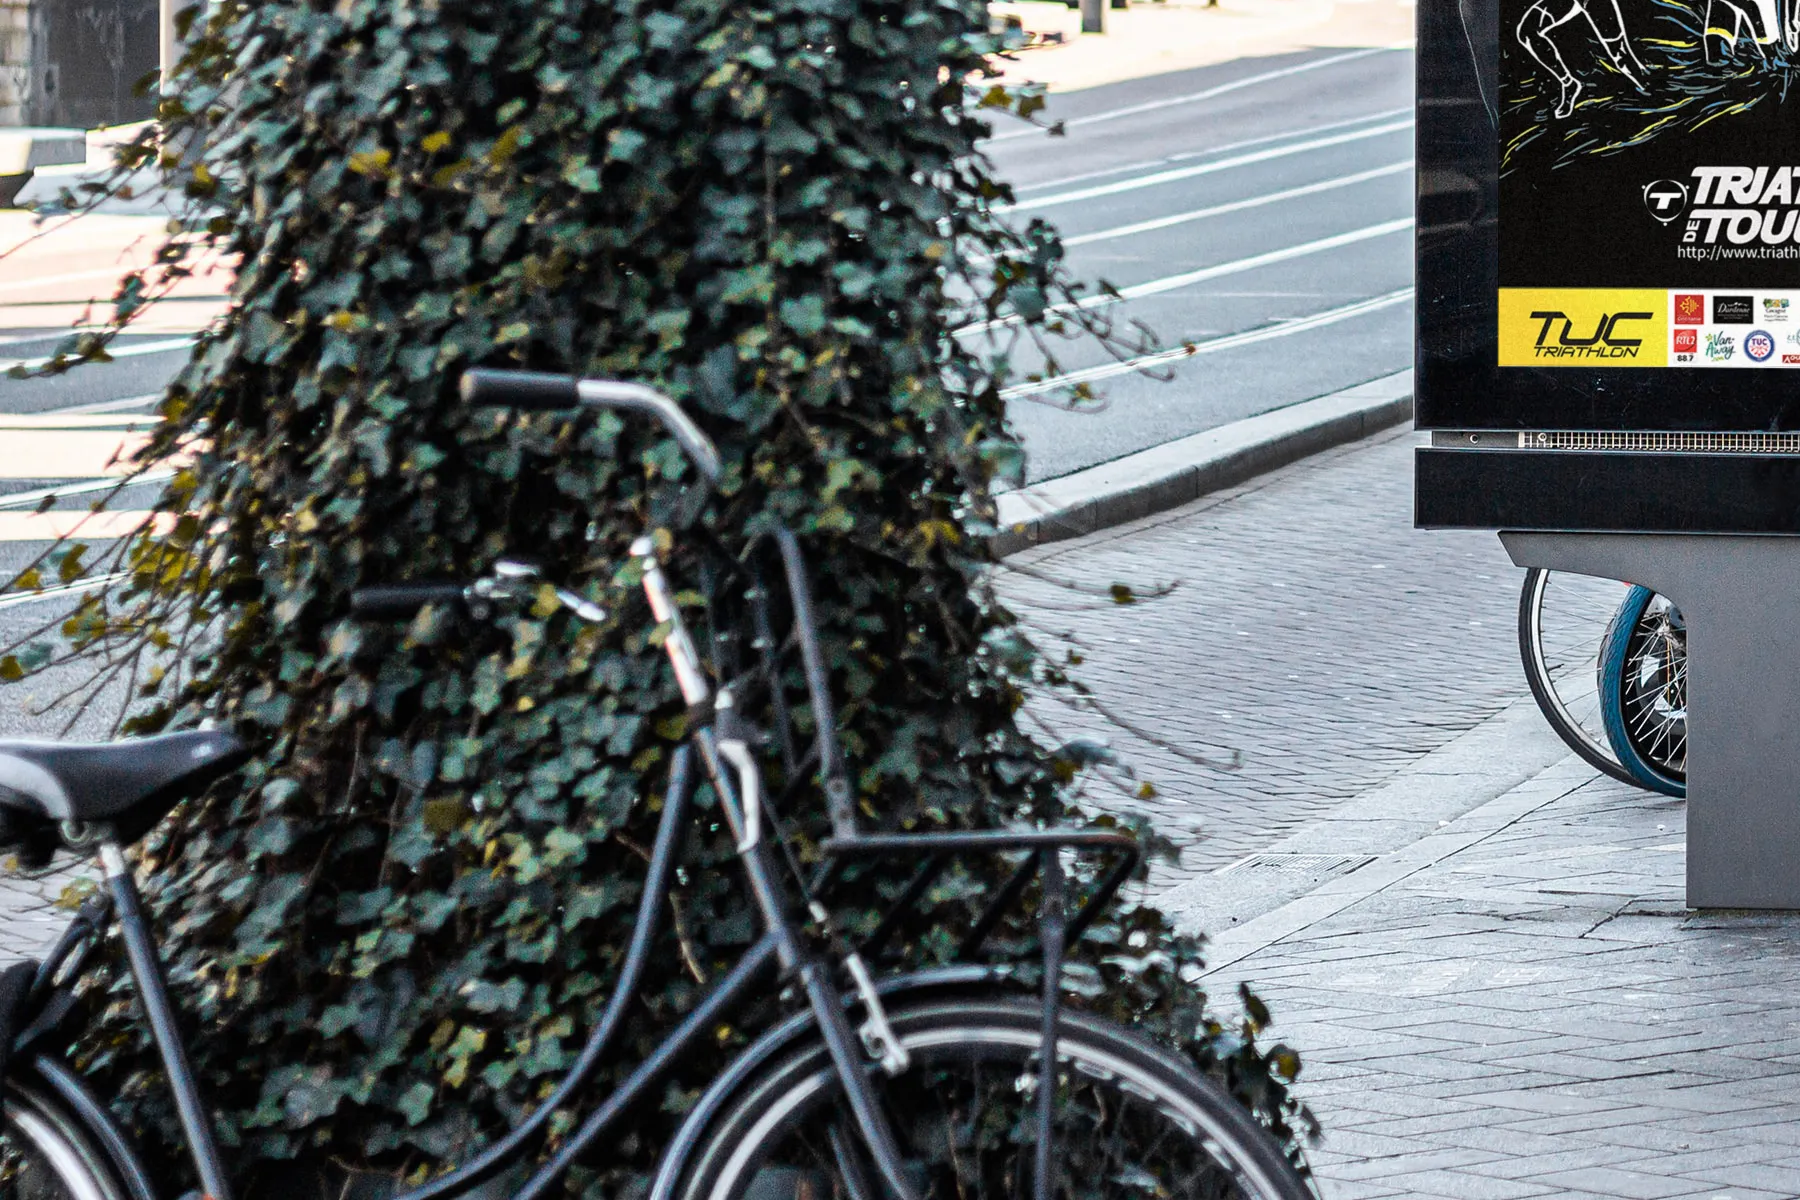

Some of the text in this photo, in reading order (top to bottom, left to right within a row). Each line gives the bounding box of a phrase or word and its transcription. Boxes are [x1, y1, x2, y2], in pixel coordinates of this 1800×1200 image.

[1682, 220, 1700, 242] DE
[1530, 311, 1654, 346] TUC
[1675, 336, 1695, 345] RTL2
[1751, 338, 1768, 346] TUC
[1534, 346, 1639, 358] TRIATHLON
